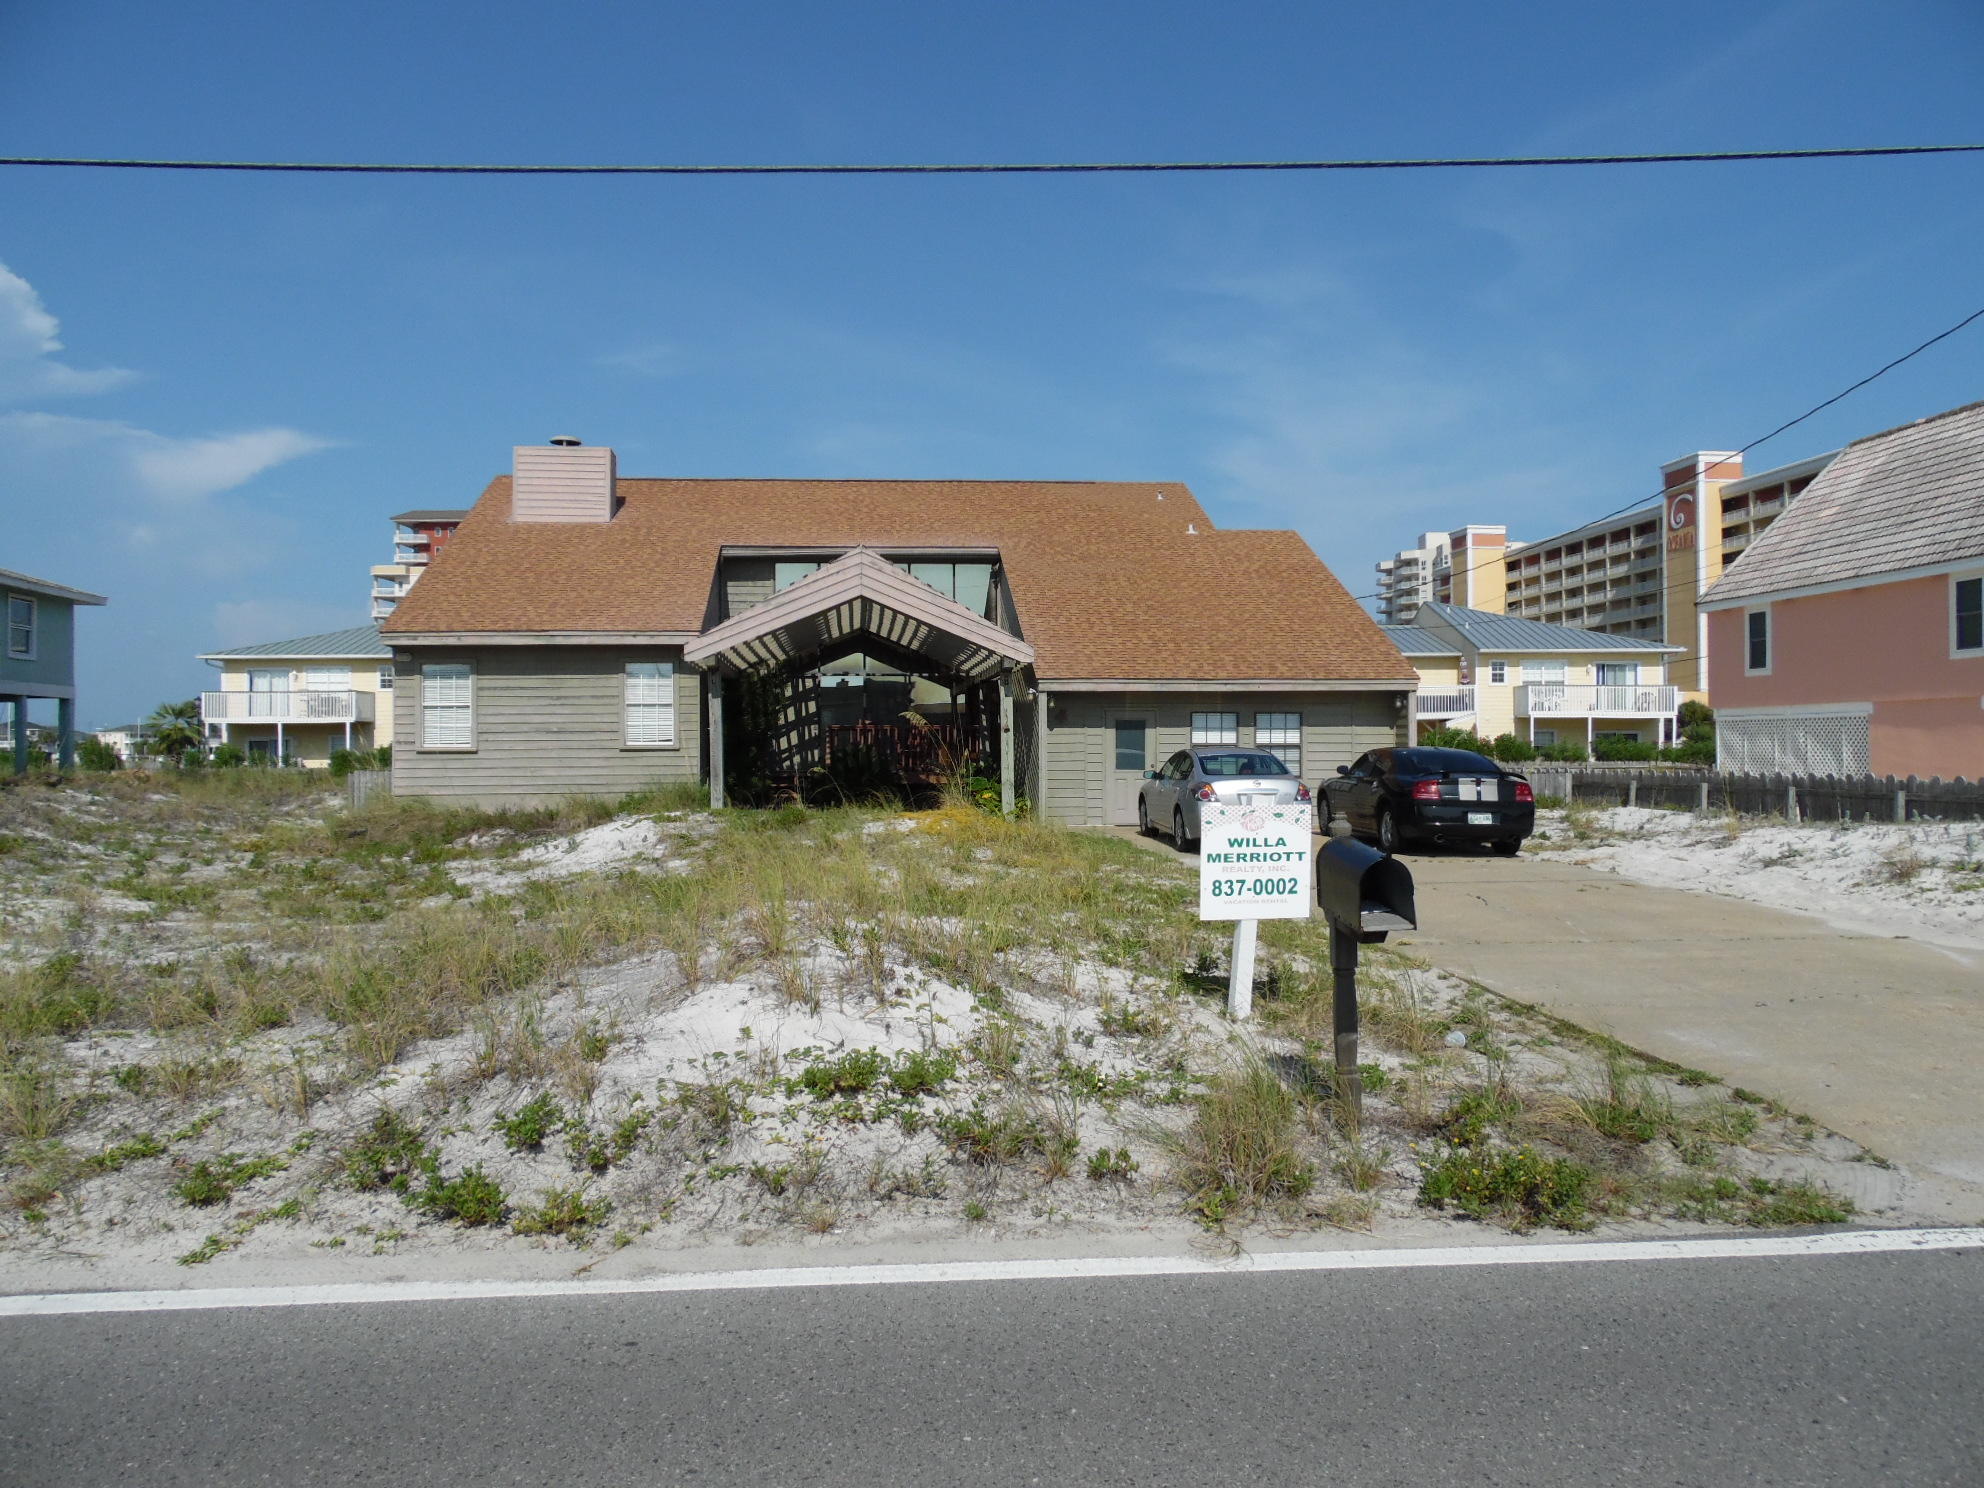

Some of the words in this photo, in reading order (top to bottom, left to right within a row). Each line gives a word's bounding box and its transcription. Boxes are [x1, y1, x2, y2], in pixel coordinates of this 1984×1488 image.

[1228, 837, 1287, 848] WILLA
[1207, 852, 1307, 863] MERRIOTT
[1211, 878, 1298, 897] 837-0002
